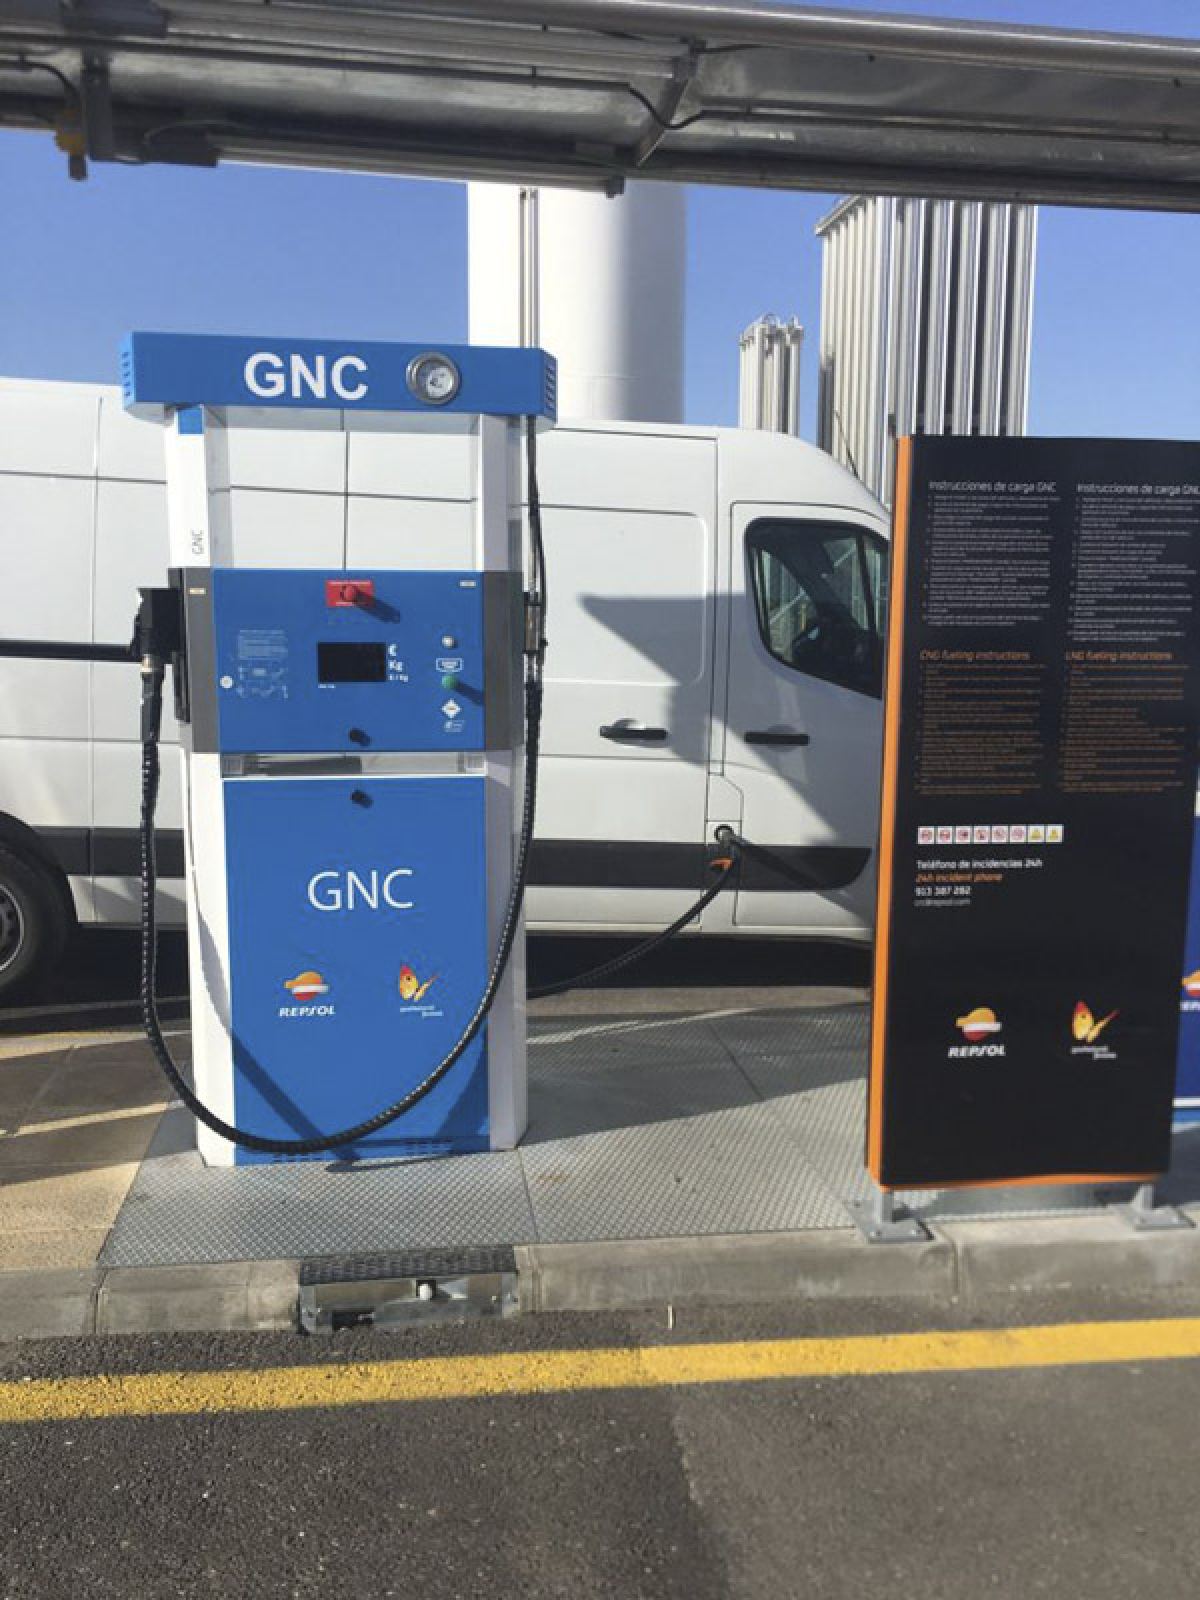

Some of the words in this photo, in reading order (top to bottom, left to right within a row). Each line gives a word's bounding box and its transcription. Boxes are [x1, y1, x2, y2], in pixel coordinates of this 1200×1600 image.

[244, 351, 368, 400] GNC
[993, 481, 1006, 492] de
[1007, 482, 1034, 494] carga
[1141, 483, 1153, 494] de
[1155, 485, 1180, 496] carga
[191, 529, 204, 555] GNC
[387, 660, 402, 673] Kg
[959, 858, 970, 869] de
[307, 869, 413, 911] GNC
[278, 1004, 336, 1018] REPSOL
[948, 1045, 1006, 1058] REPSOL
